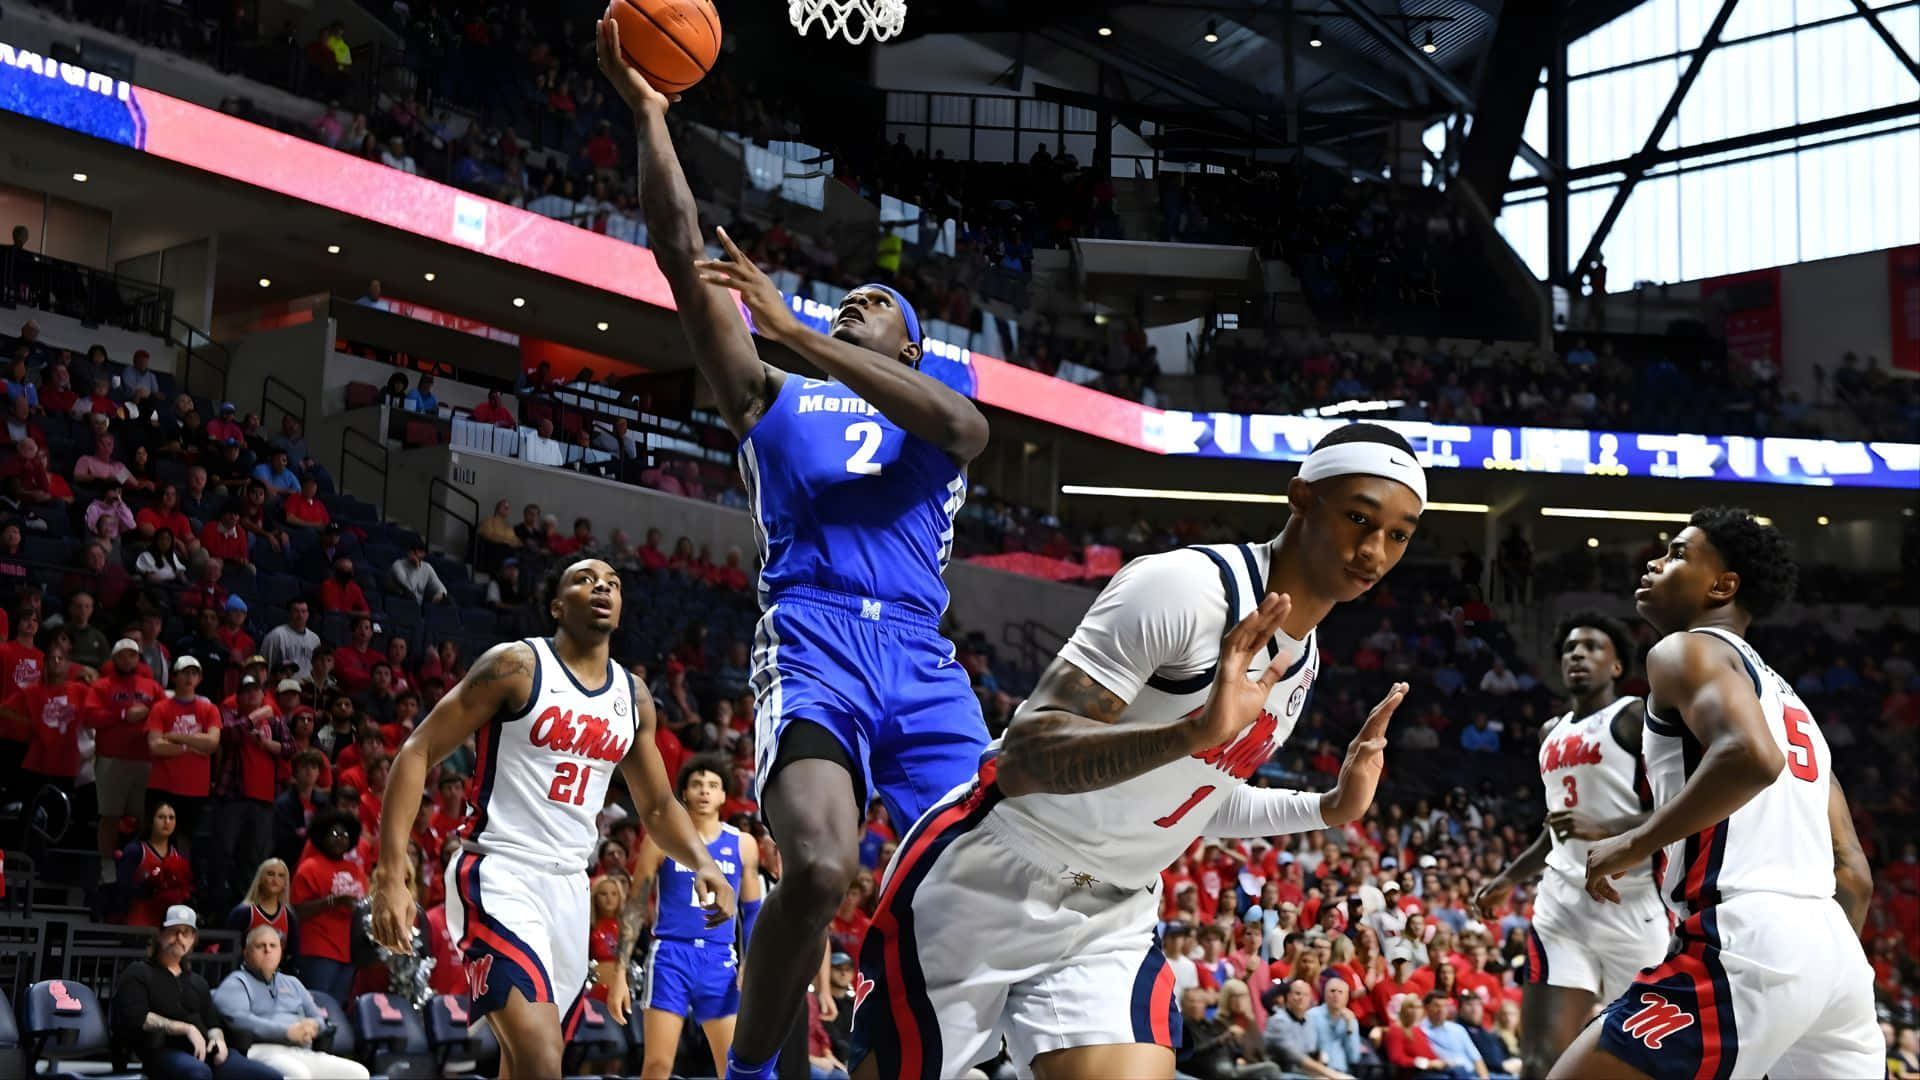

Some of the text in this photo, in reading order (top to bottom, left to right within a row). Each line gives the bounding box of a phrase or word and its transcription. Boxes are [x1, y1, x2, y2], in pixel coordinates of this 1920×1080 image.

[845, 421, 883, 476] 2
[529, 705, 577, 752] Ole
[571, 713, 628, 764] Miss
[1782, 703, 1819, 783] 5
[547, 761, 592, 806] 21
[1153, 785, 1216, 828] 1
[1562, 775, 1578, 808] 3
[1622, 992, 1695, 1050] M
